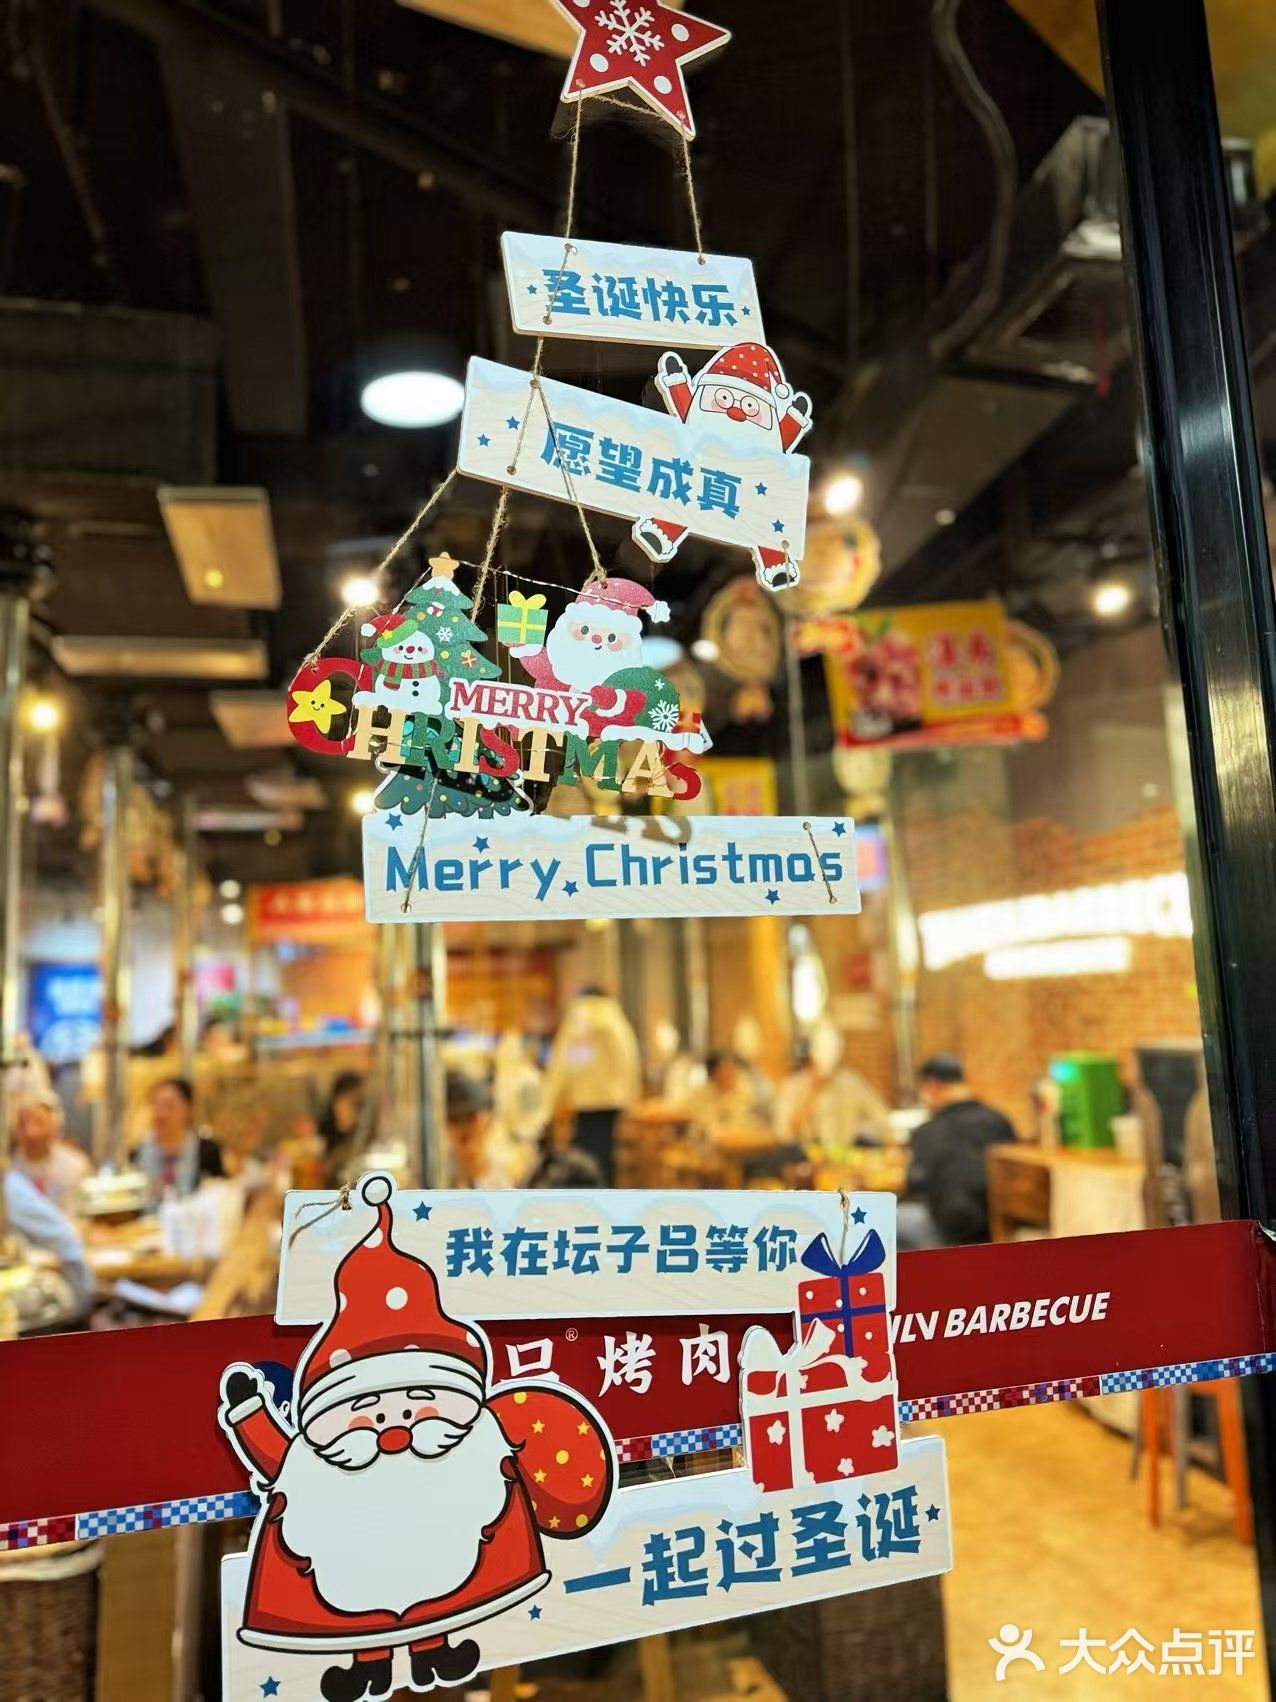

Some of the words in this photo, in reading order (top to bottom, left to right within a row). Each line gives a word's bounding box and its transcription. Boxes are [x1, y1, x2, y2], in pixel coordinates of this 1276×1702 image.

[543, 269, 738, 327] 圣诞快乐
[540, 421, 743, 520] 愿望成真
[287, 657, 702, 801] CHRISTMAS
[450, 681, 588, 726] MERRY
[386, 845, 562, 900] Merry
[585, 841, 844, 887] Christmas
[445, 1224, 798, 1278] 我在坛子吕等你
[943, 1291, 1111, 1339] BARBECUE
[563, 1484, 921, 1607] 一起过圣诞
